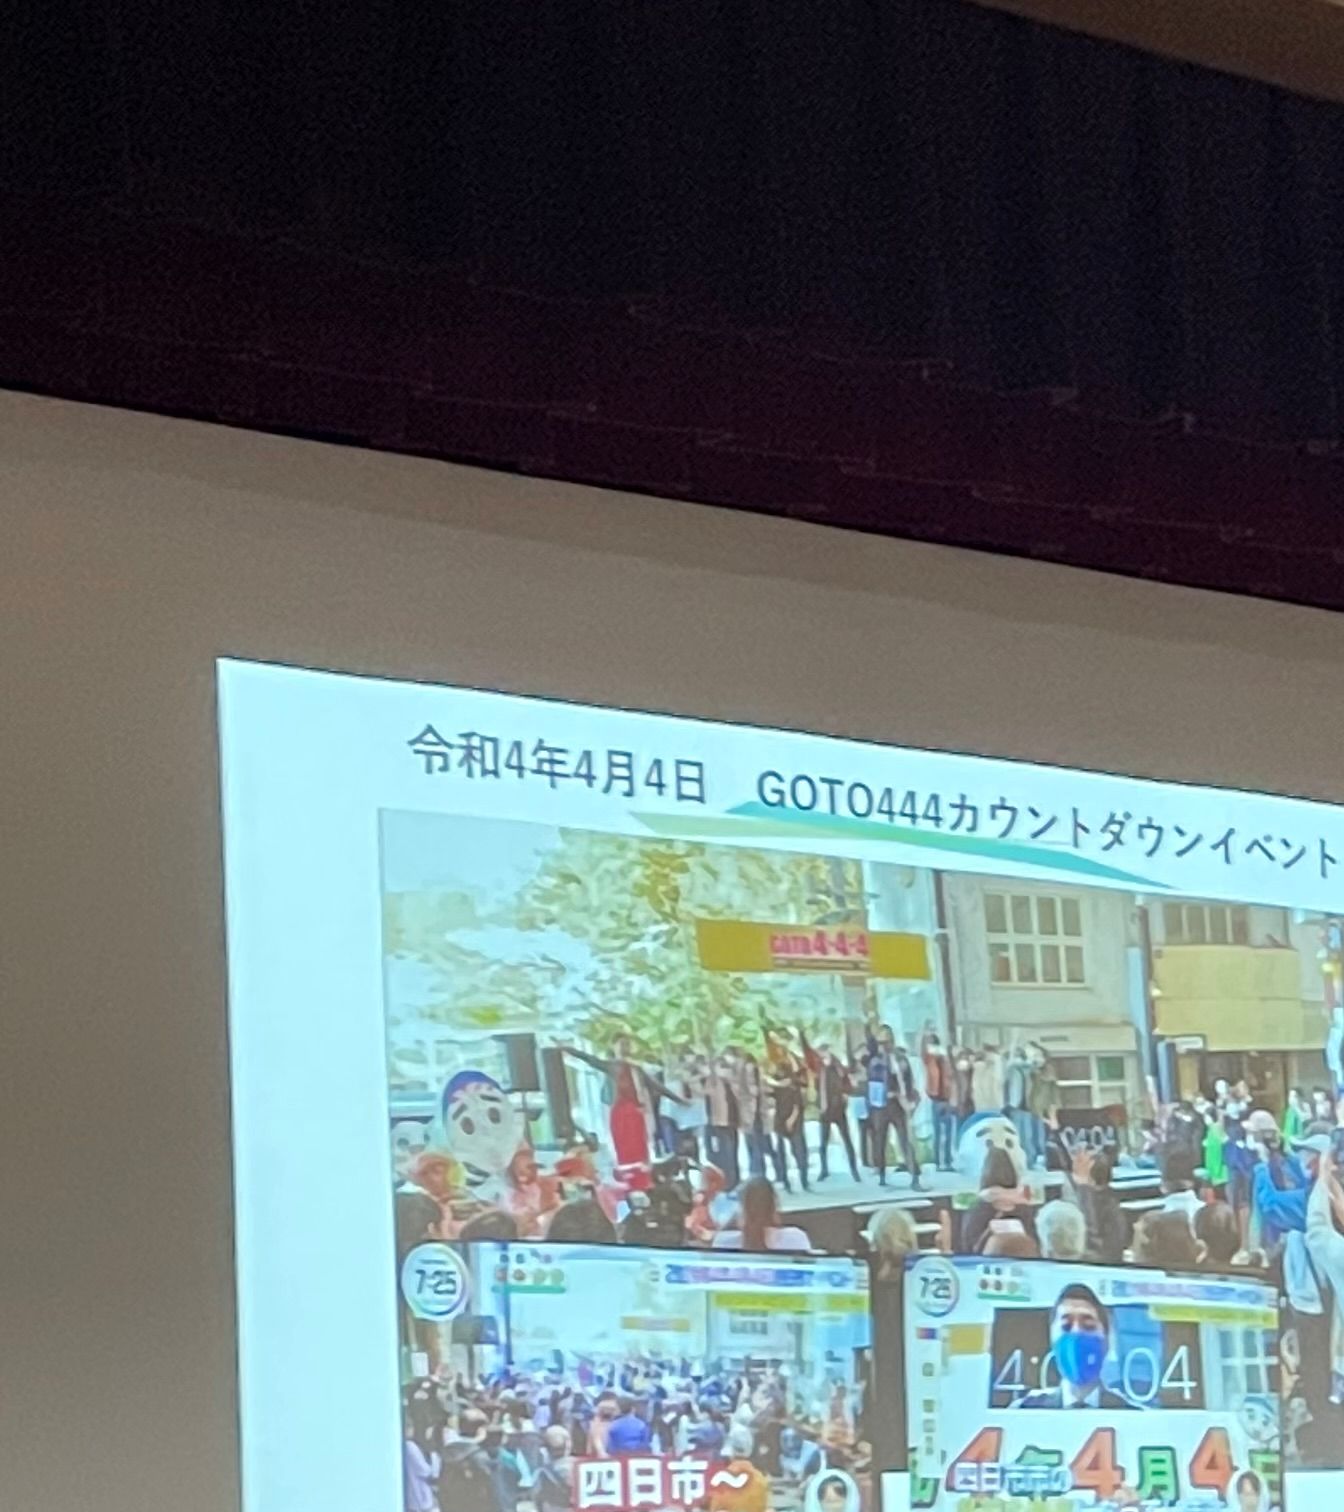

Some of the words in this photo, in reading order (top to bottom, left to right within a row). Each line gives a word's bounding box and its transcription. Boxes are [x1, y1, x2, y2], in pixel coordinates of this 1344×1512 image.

[407, 723, 706, 804] 令和4年4月4日
[756, 770, 1337, 879] GOTO444カウントダウンイベント
